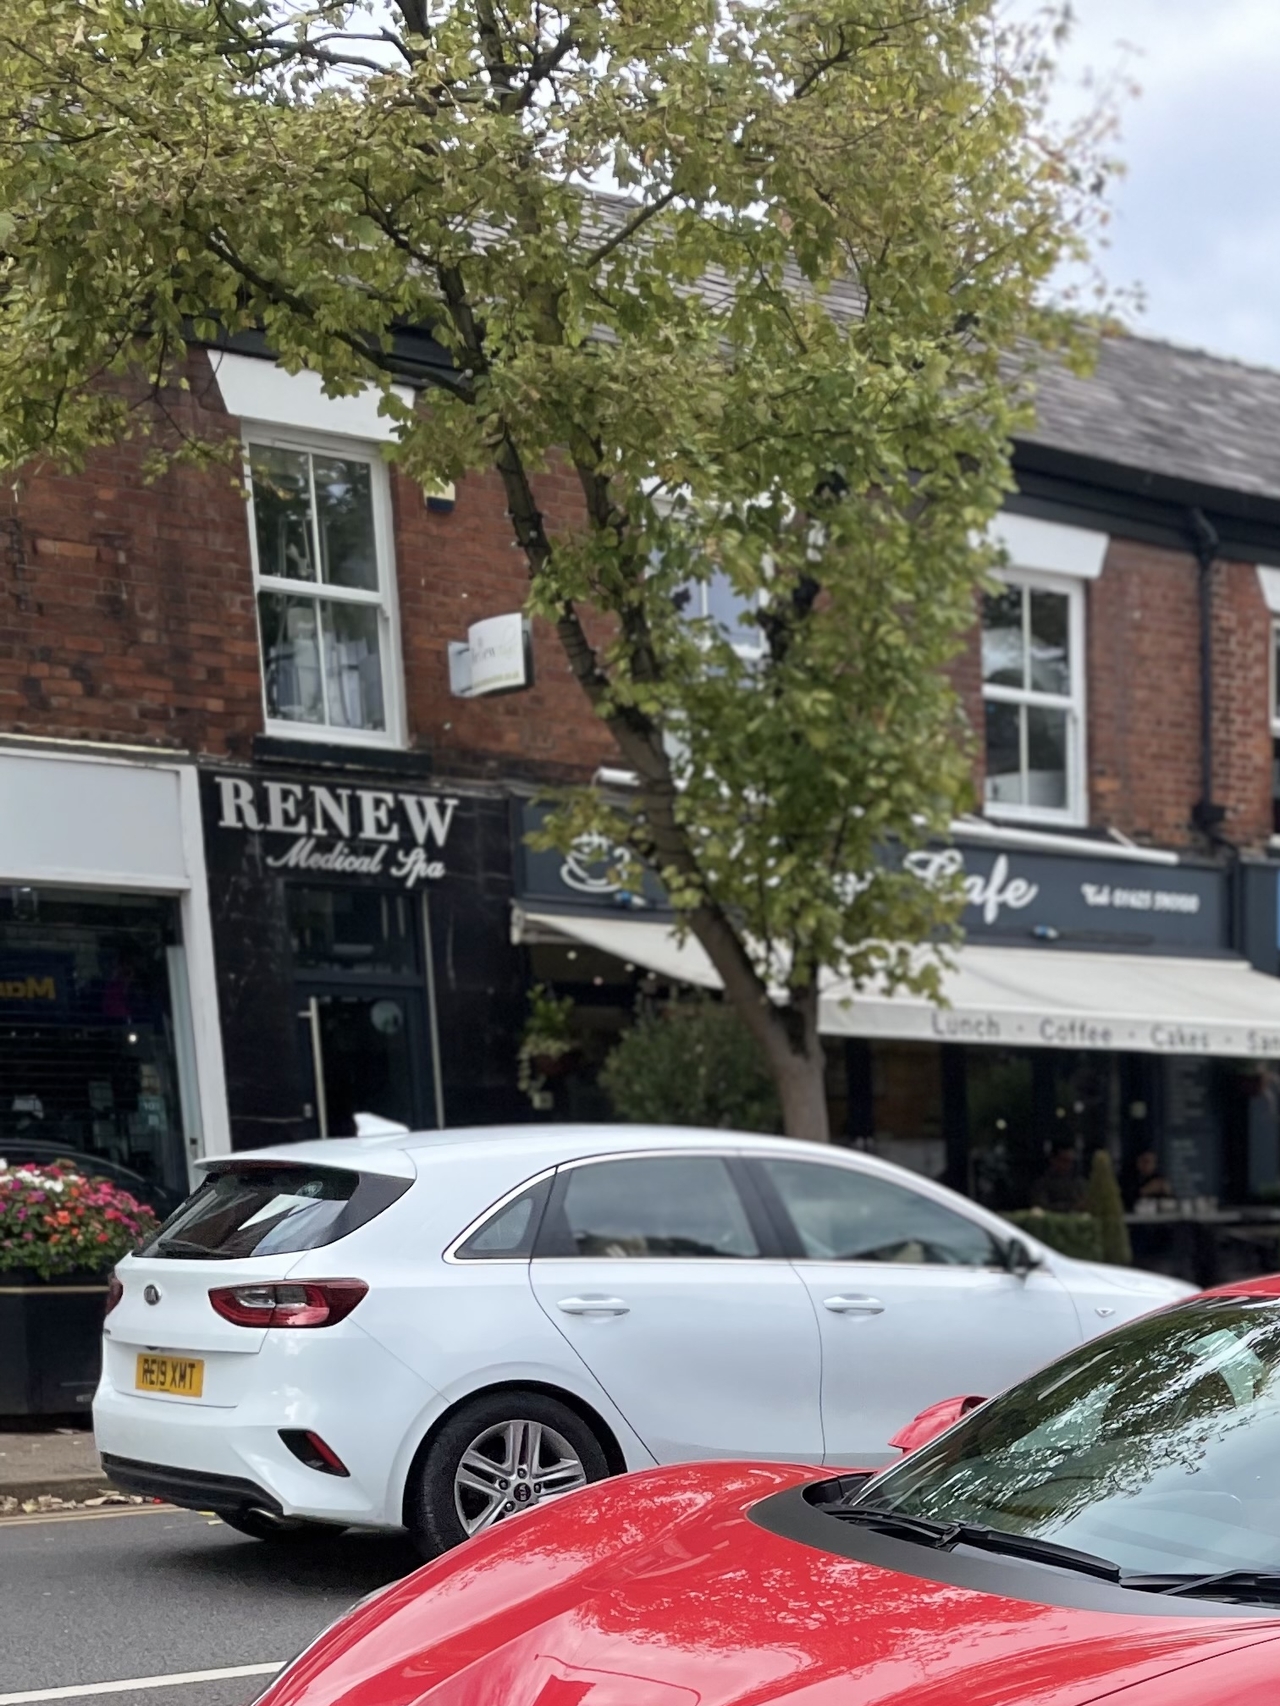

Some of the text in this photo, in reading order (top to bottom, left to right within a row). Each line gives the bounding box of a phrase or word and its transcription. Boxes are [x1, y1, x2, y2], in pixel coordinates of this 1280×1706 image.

[214, 776, 460, 847] RENEW
[266, 836, 446, 888] Medical Spa
[931, 1011, 1001, 1038] Lunch
[1039, 1017, 1112, 1043] Coffee
[1151, 1023, 1210, 1048] Cakes
[170, 1361, 196, 1390] XMT
